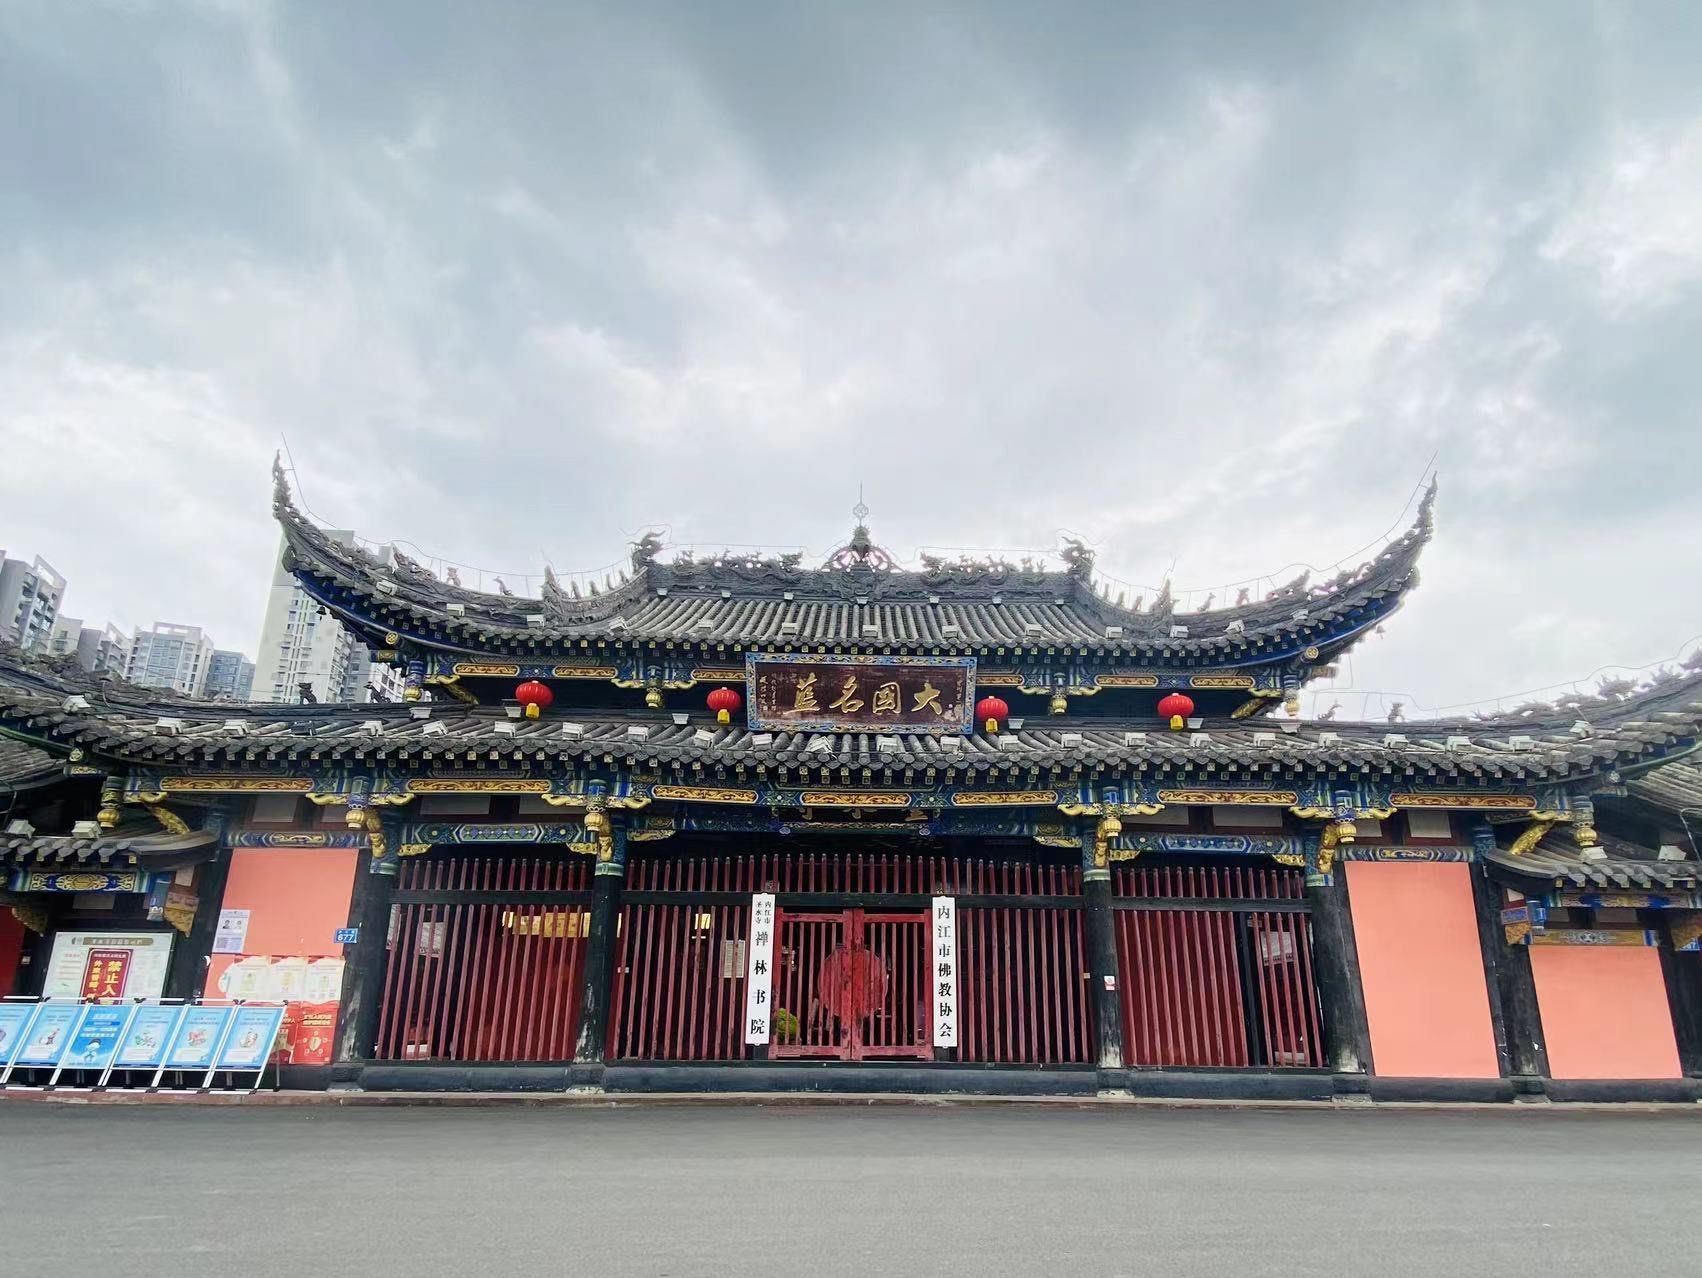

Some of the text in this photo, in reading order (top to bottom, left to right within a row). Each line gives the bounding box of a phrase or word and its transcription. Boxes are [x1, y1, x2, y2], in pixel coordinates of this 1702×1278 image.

[750, 930, 769, 1035] 禅林书院
[937, 905, 953, 1038] 内江市佛教协会
